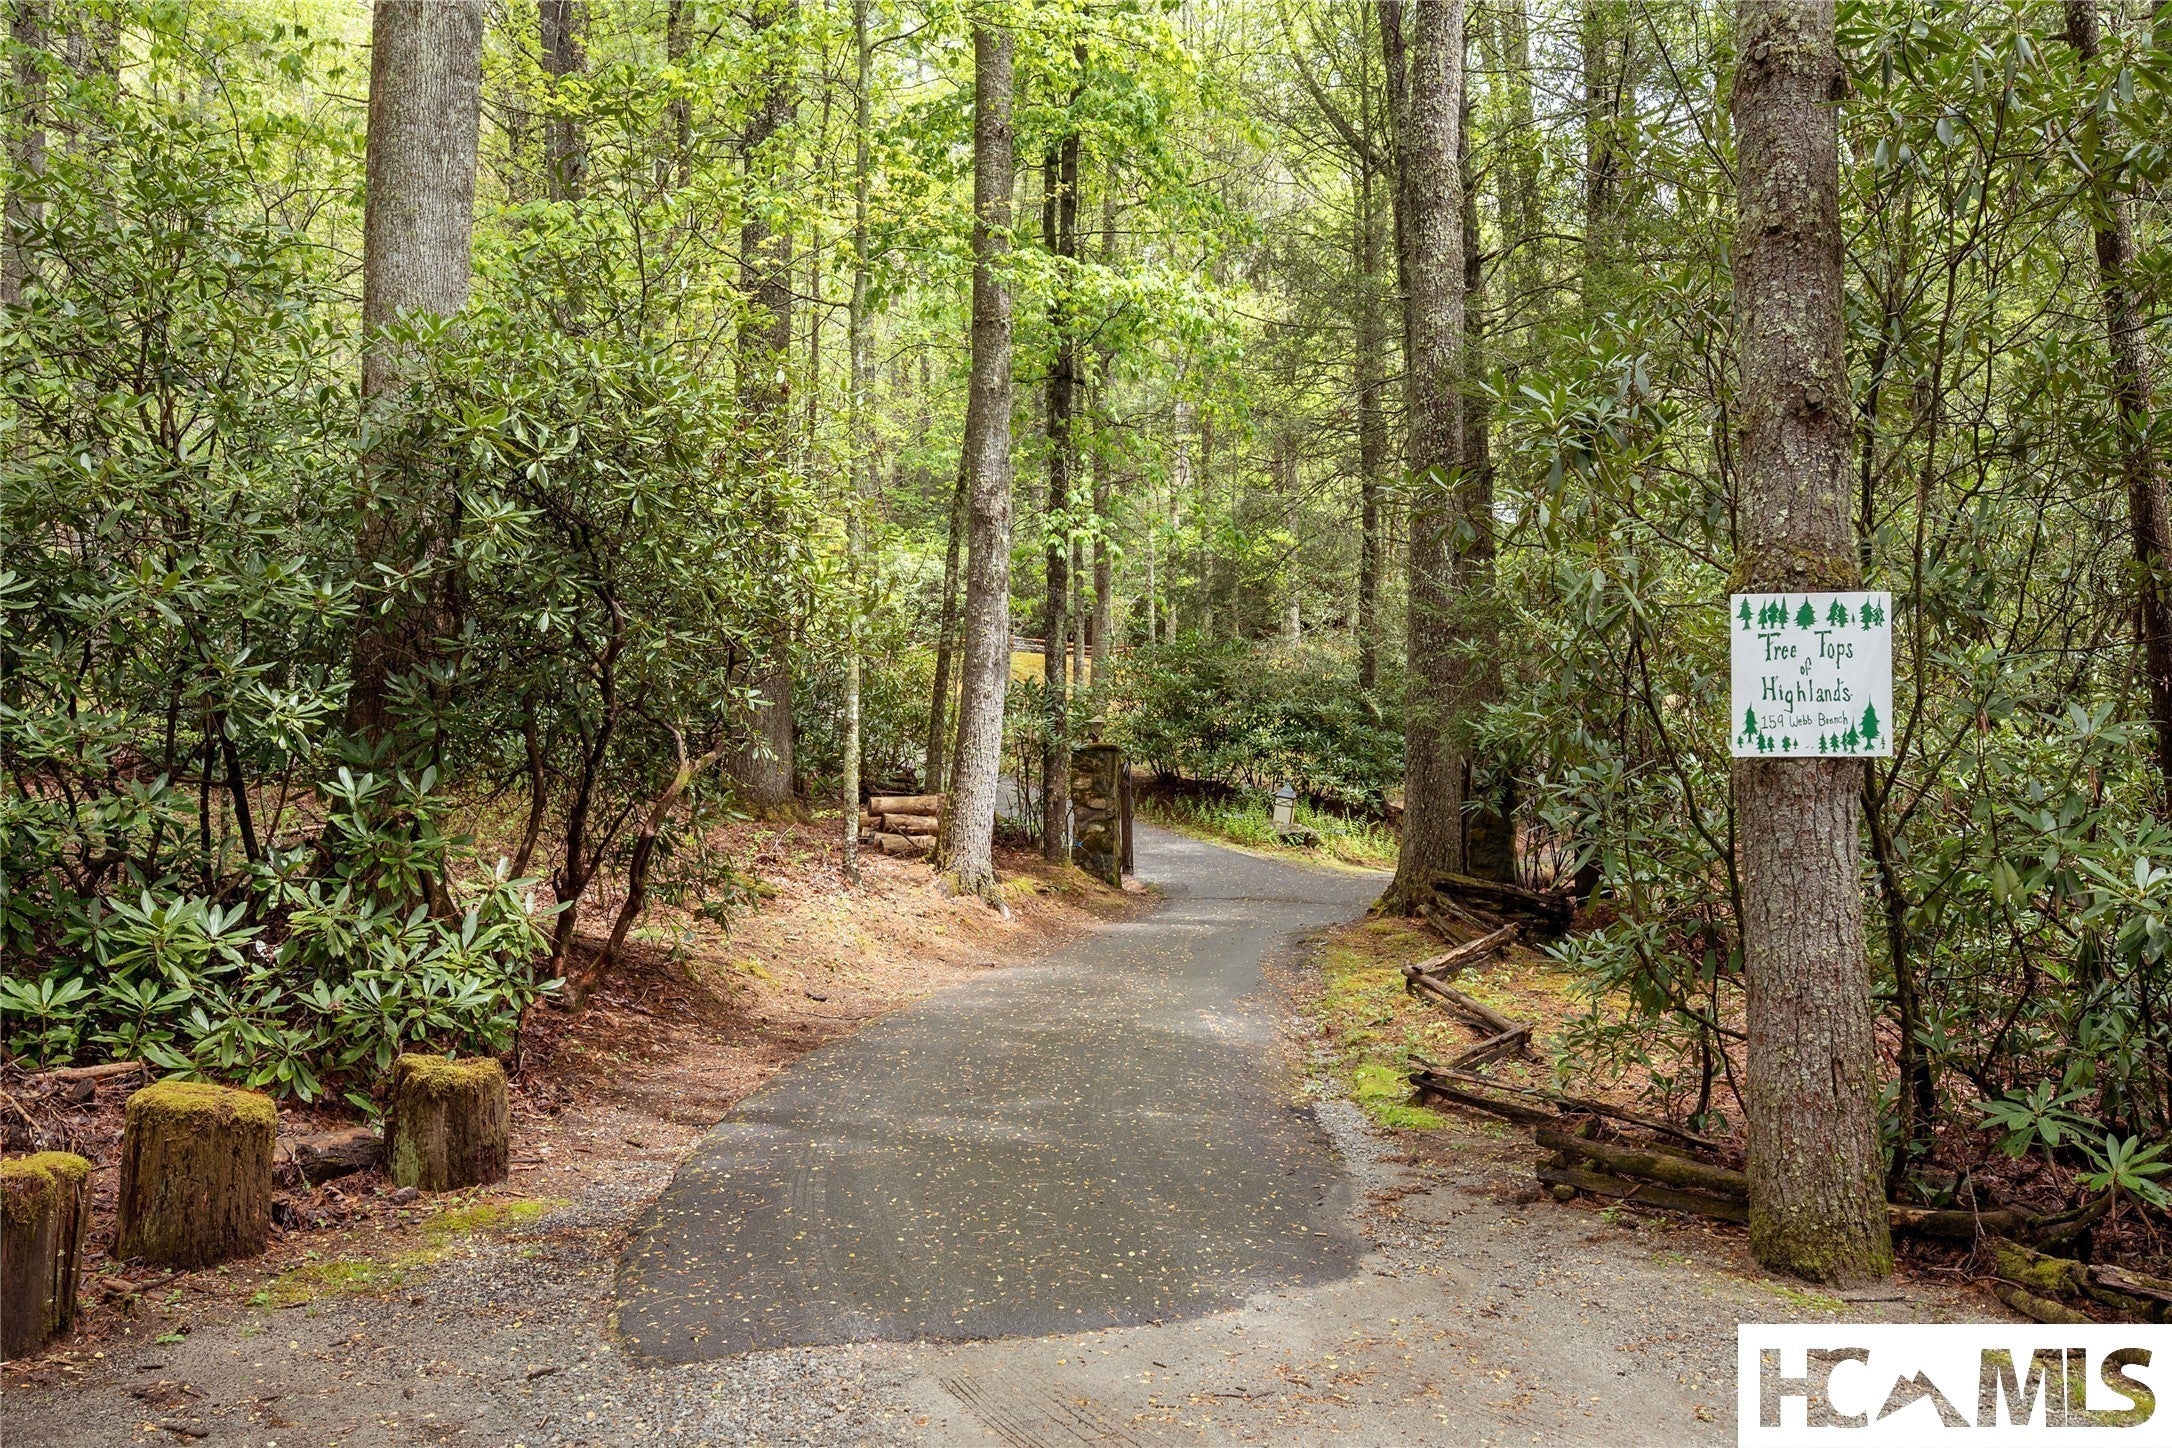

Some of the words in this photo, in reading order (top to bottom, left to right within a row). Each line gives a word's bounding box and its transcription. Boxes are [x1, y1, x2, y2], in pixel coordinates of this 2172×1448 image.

[1758, 632, 1797, 662] Tree
[1814, 630, 1853, 669] Tops
[1800, 657, 1812, 675] of
[1761, 676, 1853, 713] Highlands
[1761, 714, 1784, 729] 159
[1789, 713, 1813, 728] Webb
[1818, 711, 1848, 726] Branch
